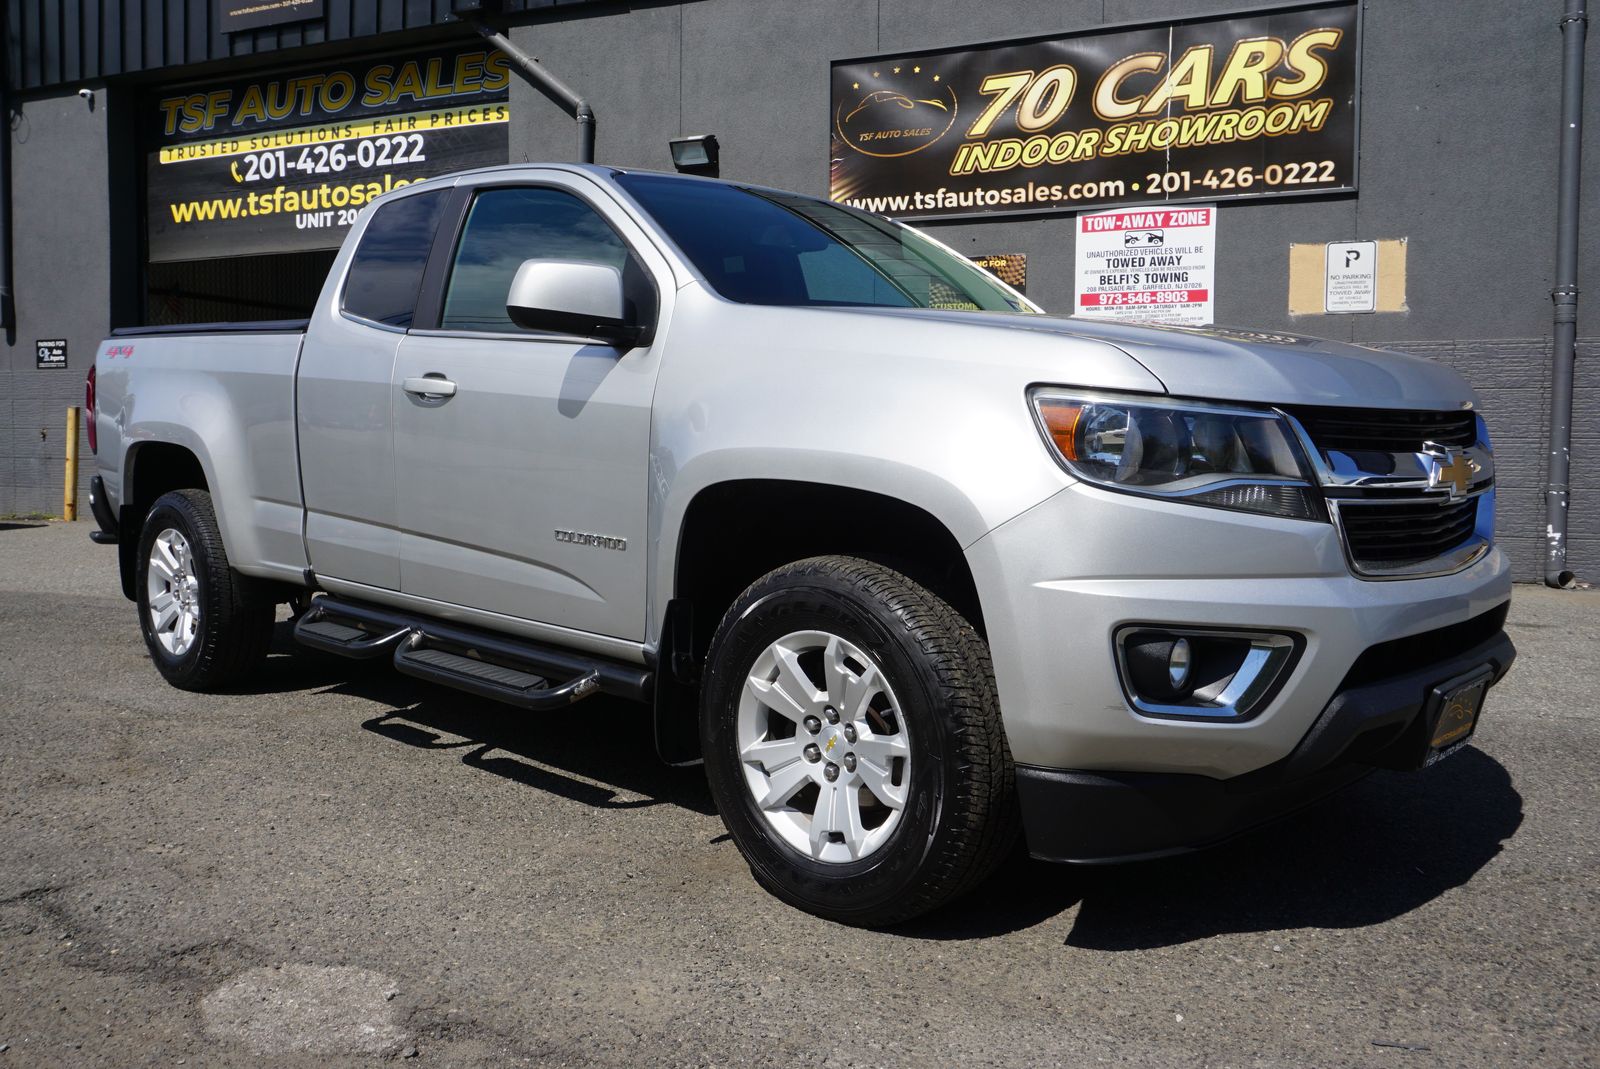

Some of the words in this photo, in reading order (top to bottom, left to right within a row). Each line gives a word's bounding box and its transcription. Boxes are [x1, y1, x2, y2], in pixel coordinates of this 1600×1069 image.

[160, 90, 232, 135] TSF
[232, 71, 356, 126] AUTO
[361, 50, 509, 107] SALES
[965, 63, 1077, 139] 70
[1092, 27, 1343, 121] CARS
[167, 140, 239, 161] TRUSTED
[251, 125, 360, 149] SOLUTIONS,
[373, 116, 416, 134] FAIR
[430, 106, 505, 127] PRICES
[859, 132, 875, 142] TSF
[875, 129, 901, 140] AUTO
[903, 128, 932, 137] SALES
[950, 128, 1102, 176] INDOOR
[1100, 98, 1334, 158] SHOWROOM
[243, 133, 426, 182] 201-426-0222
[846, 179, 1124, 213] www.tsfautosales.com
[1146, 160, 1336, 194] 201-426-0222
[170, 174, 428, 224] www.tsfautosal
[295, 211, 335, 229] UNIT
[1085, 212, 1164, 231] TOW-AWAY
[1169, 211, 1206, 226] ZONE
[1086, 248, 1139, 258] UNAUTHORIZED
[1140, 247, 1175, 256] VEHICLES
[1175, 246, 1192, 254] WILL
[1106, 256, 1145, 268] TOWED
[1149, 255, 1183, 266] AWAY
[989, 259, 1007, 268] FOR
[1100, 273, 1140, 286] BELFI'S
[1144, 271, 1189, 284] TOWING
[1099, 290, 1189, 305] 973-546-8903
[554, 529, 626, 551] COLORADO
